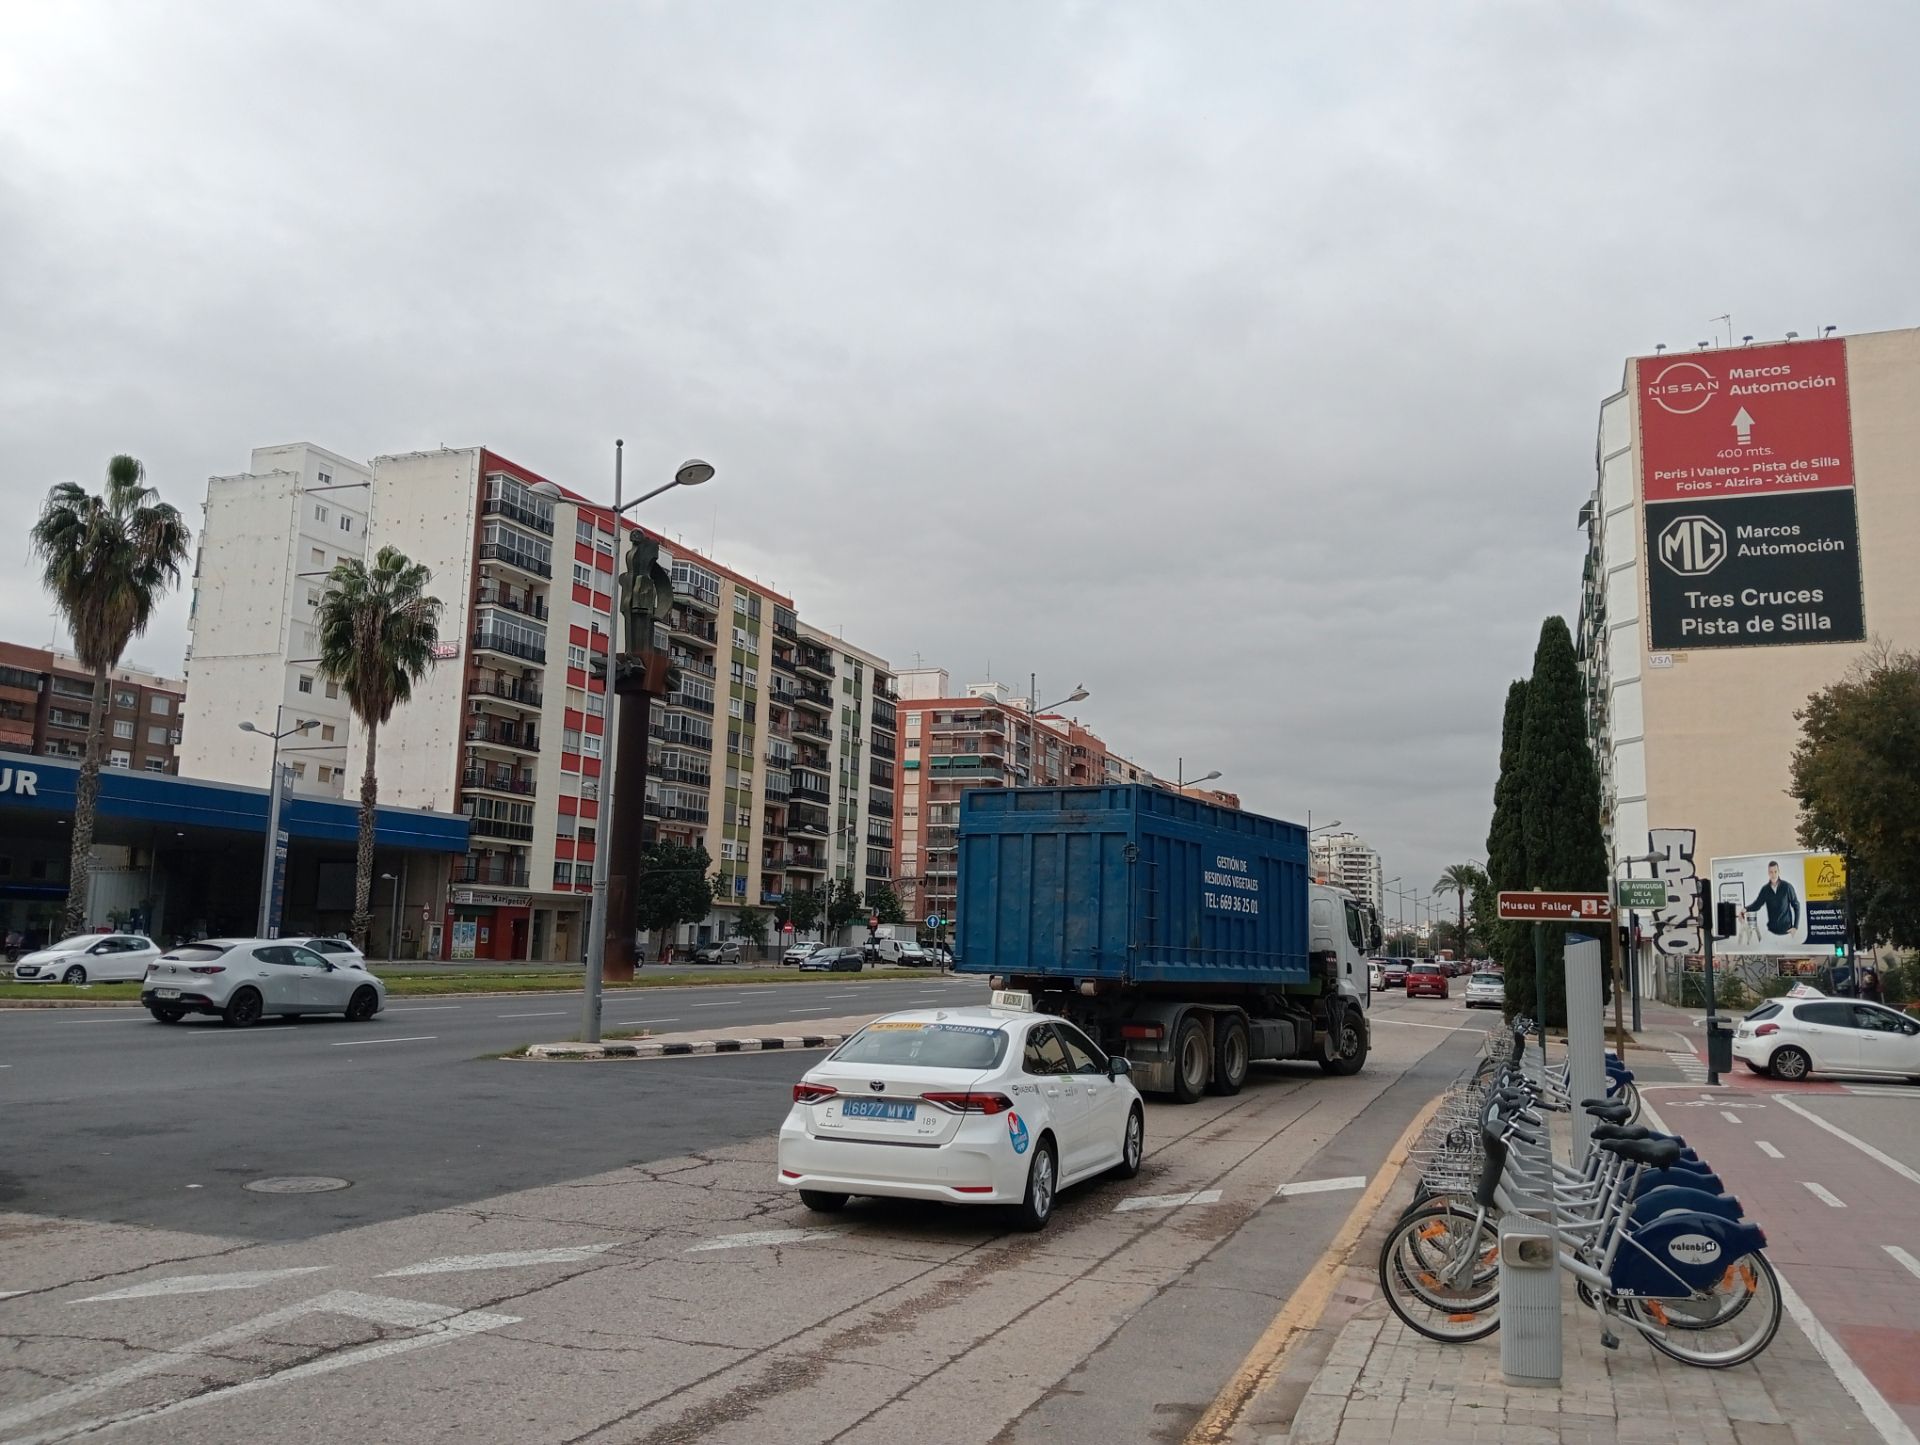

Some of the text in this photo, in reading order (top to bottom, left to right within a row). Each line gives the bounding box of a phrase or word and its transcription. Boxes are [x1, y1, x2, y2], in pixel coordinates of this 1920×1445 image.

[1729, 365, 1791, 379] Marcos
[1648, 381, 1719, 395] NISSAN
[1729, 375, 1836, 396] Automoción
[1716, 446, 1775, 458] 400 mts.
[1654, 468, 1688, 480] Peris
[1690, 467, 1695, 477] i
[1697, 465, 1740, 477] Valero
[1752, 461, 1787, 473] Pista
[1790, 459, 1808, 470] de
[1810, 457, 1840, 468] Silla
[1676, 480, 1713, 492] Foios
[1724, 476, 1763, 488] Alzira
[1775, 472, 1819, 484] Xàtiva
[1736, 525, 1801, 539] Marcos
[1664, 520, 1721, 571] MG
[1737, 538, 1845, 557] Automoción
[1684, 588, 1825, 609] Tres Cruces
[1681, 612, 1832, 635] Pista de Silla
[1216, 855, 1248, 873] GESTIÓN DE
[1204, 871, 1258, 891] RESIDUOS VEGETALES
[1631, 882, 1663, 890] AVINGUDA
[1204, 892, 1258, 914] TEL: 669 36 25 01
[1501, 901, 1573, 911] Museu Faller
[826, 1107, 834, 1118] E
[851, 1102, 913, 1119] 6877 MWY
[922, 1117, 937, 1126] 189
